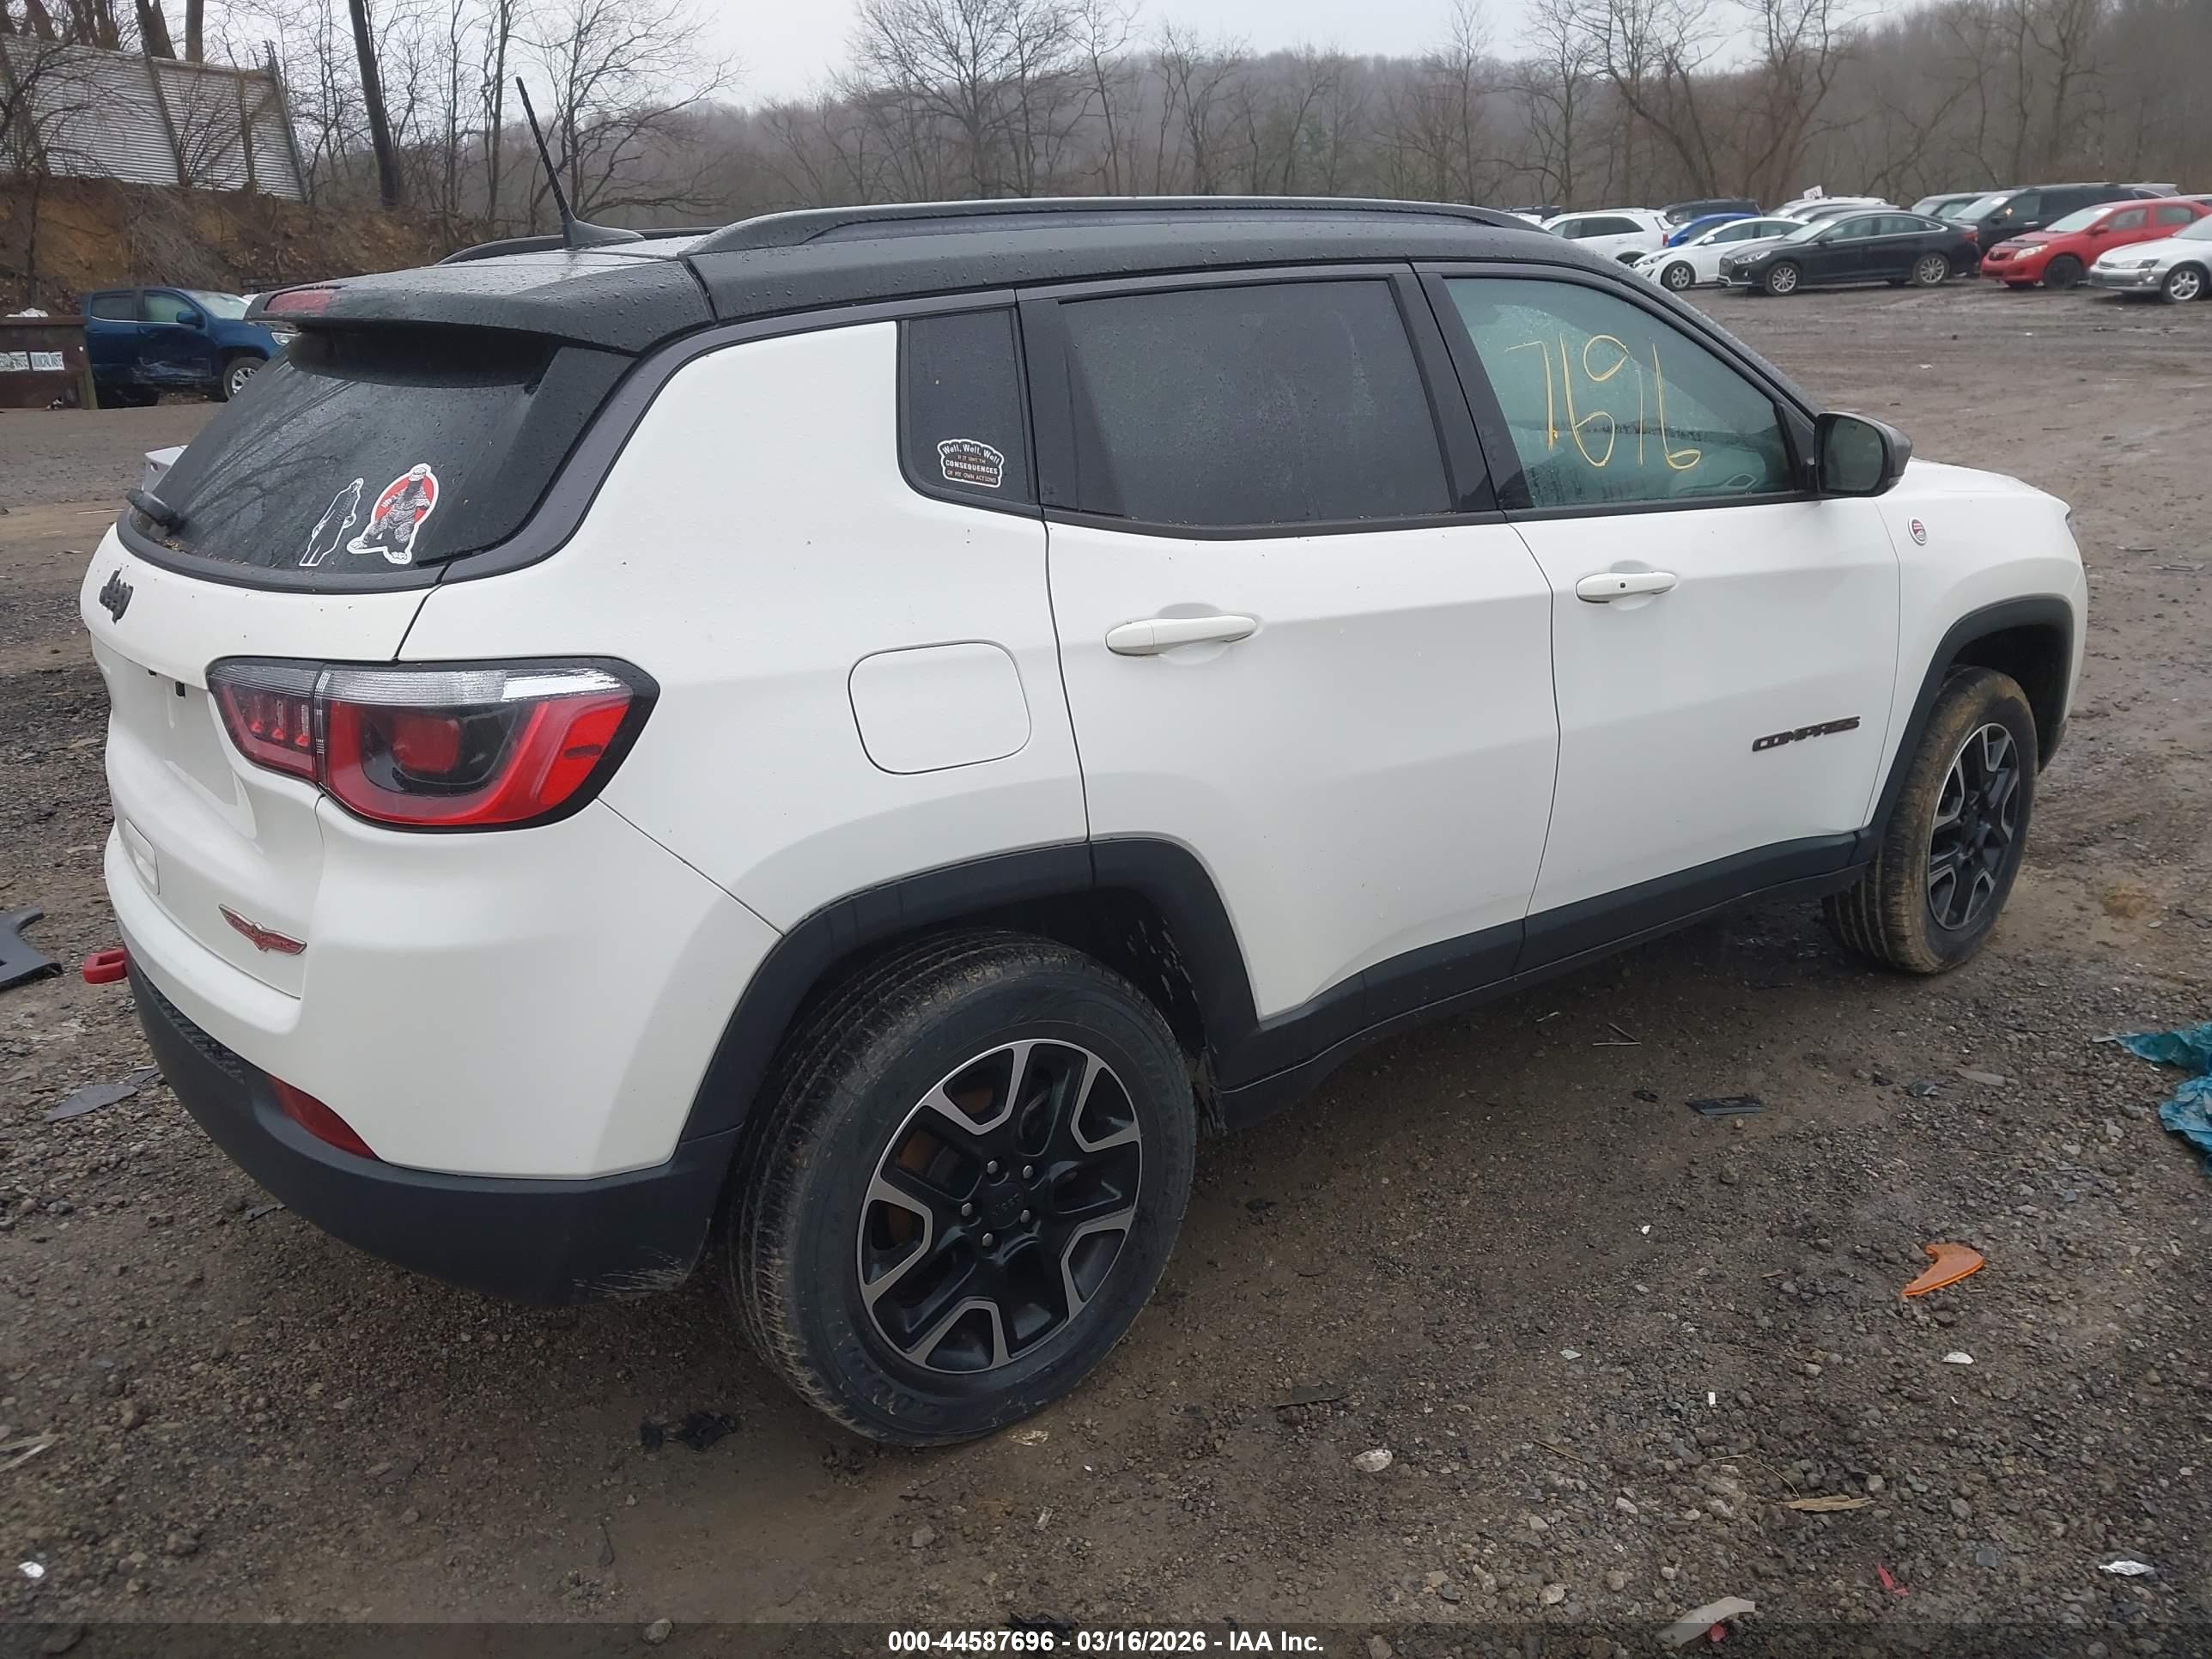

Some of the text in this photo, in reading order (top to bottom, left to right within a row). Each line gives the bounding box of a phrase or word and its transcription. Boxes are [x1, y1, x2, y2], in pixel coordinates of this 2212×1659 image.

[1504, 332, 1702, 470] 7696
[942, 443, 1000, 465] Well, Well, Well
[945, 459, 998, 475] CONSEQUENCES
